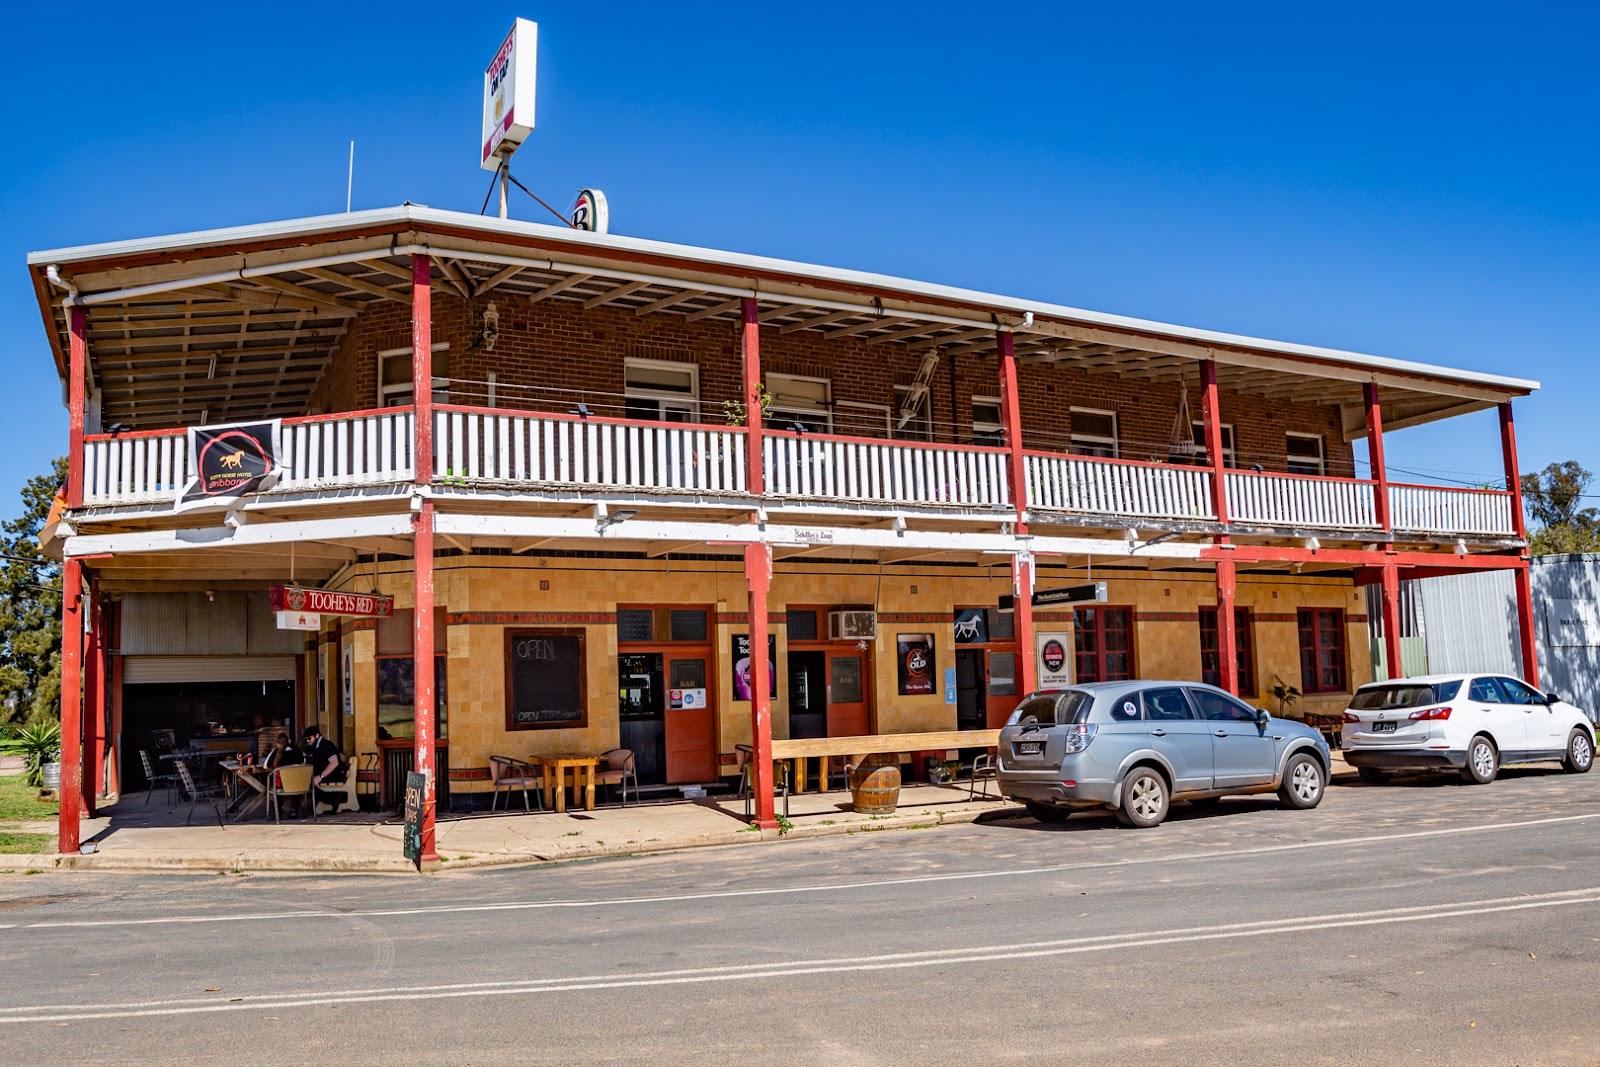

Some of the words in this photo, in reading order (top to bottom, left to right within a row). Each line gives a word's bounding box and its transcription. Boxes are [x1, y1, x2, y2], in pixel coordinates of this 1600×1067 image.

[309, 592, 356, 612] TOOHEYS
[355, 597, 373, 613] RED
[516, 639, 554, 660] OPEN
[910, 660, 926, 669] OLD
